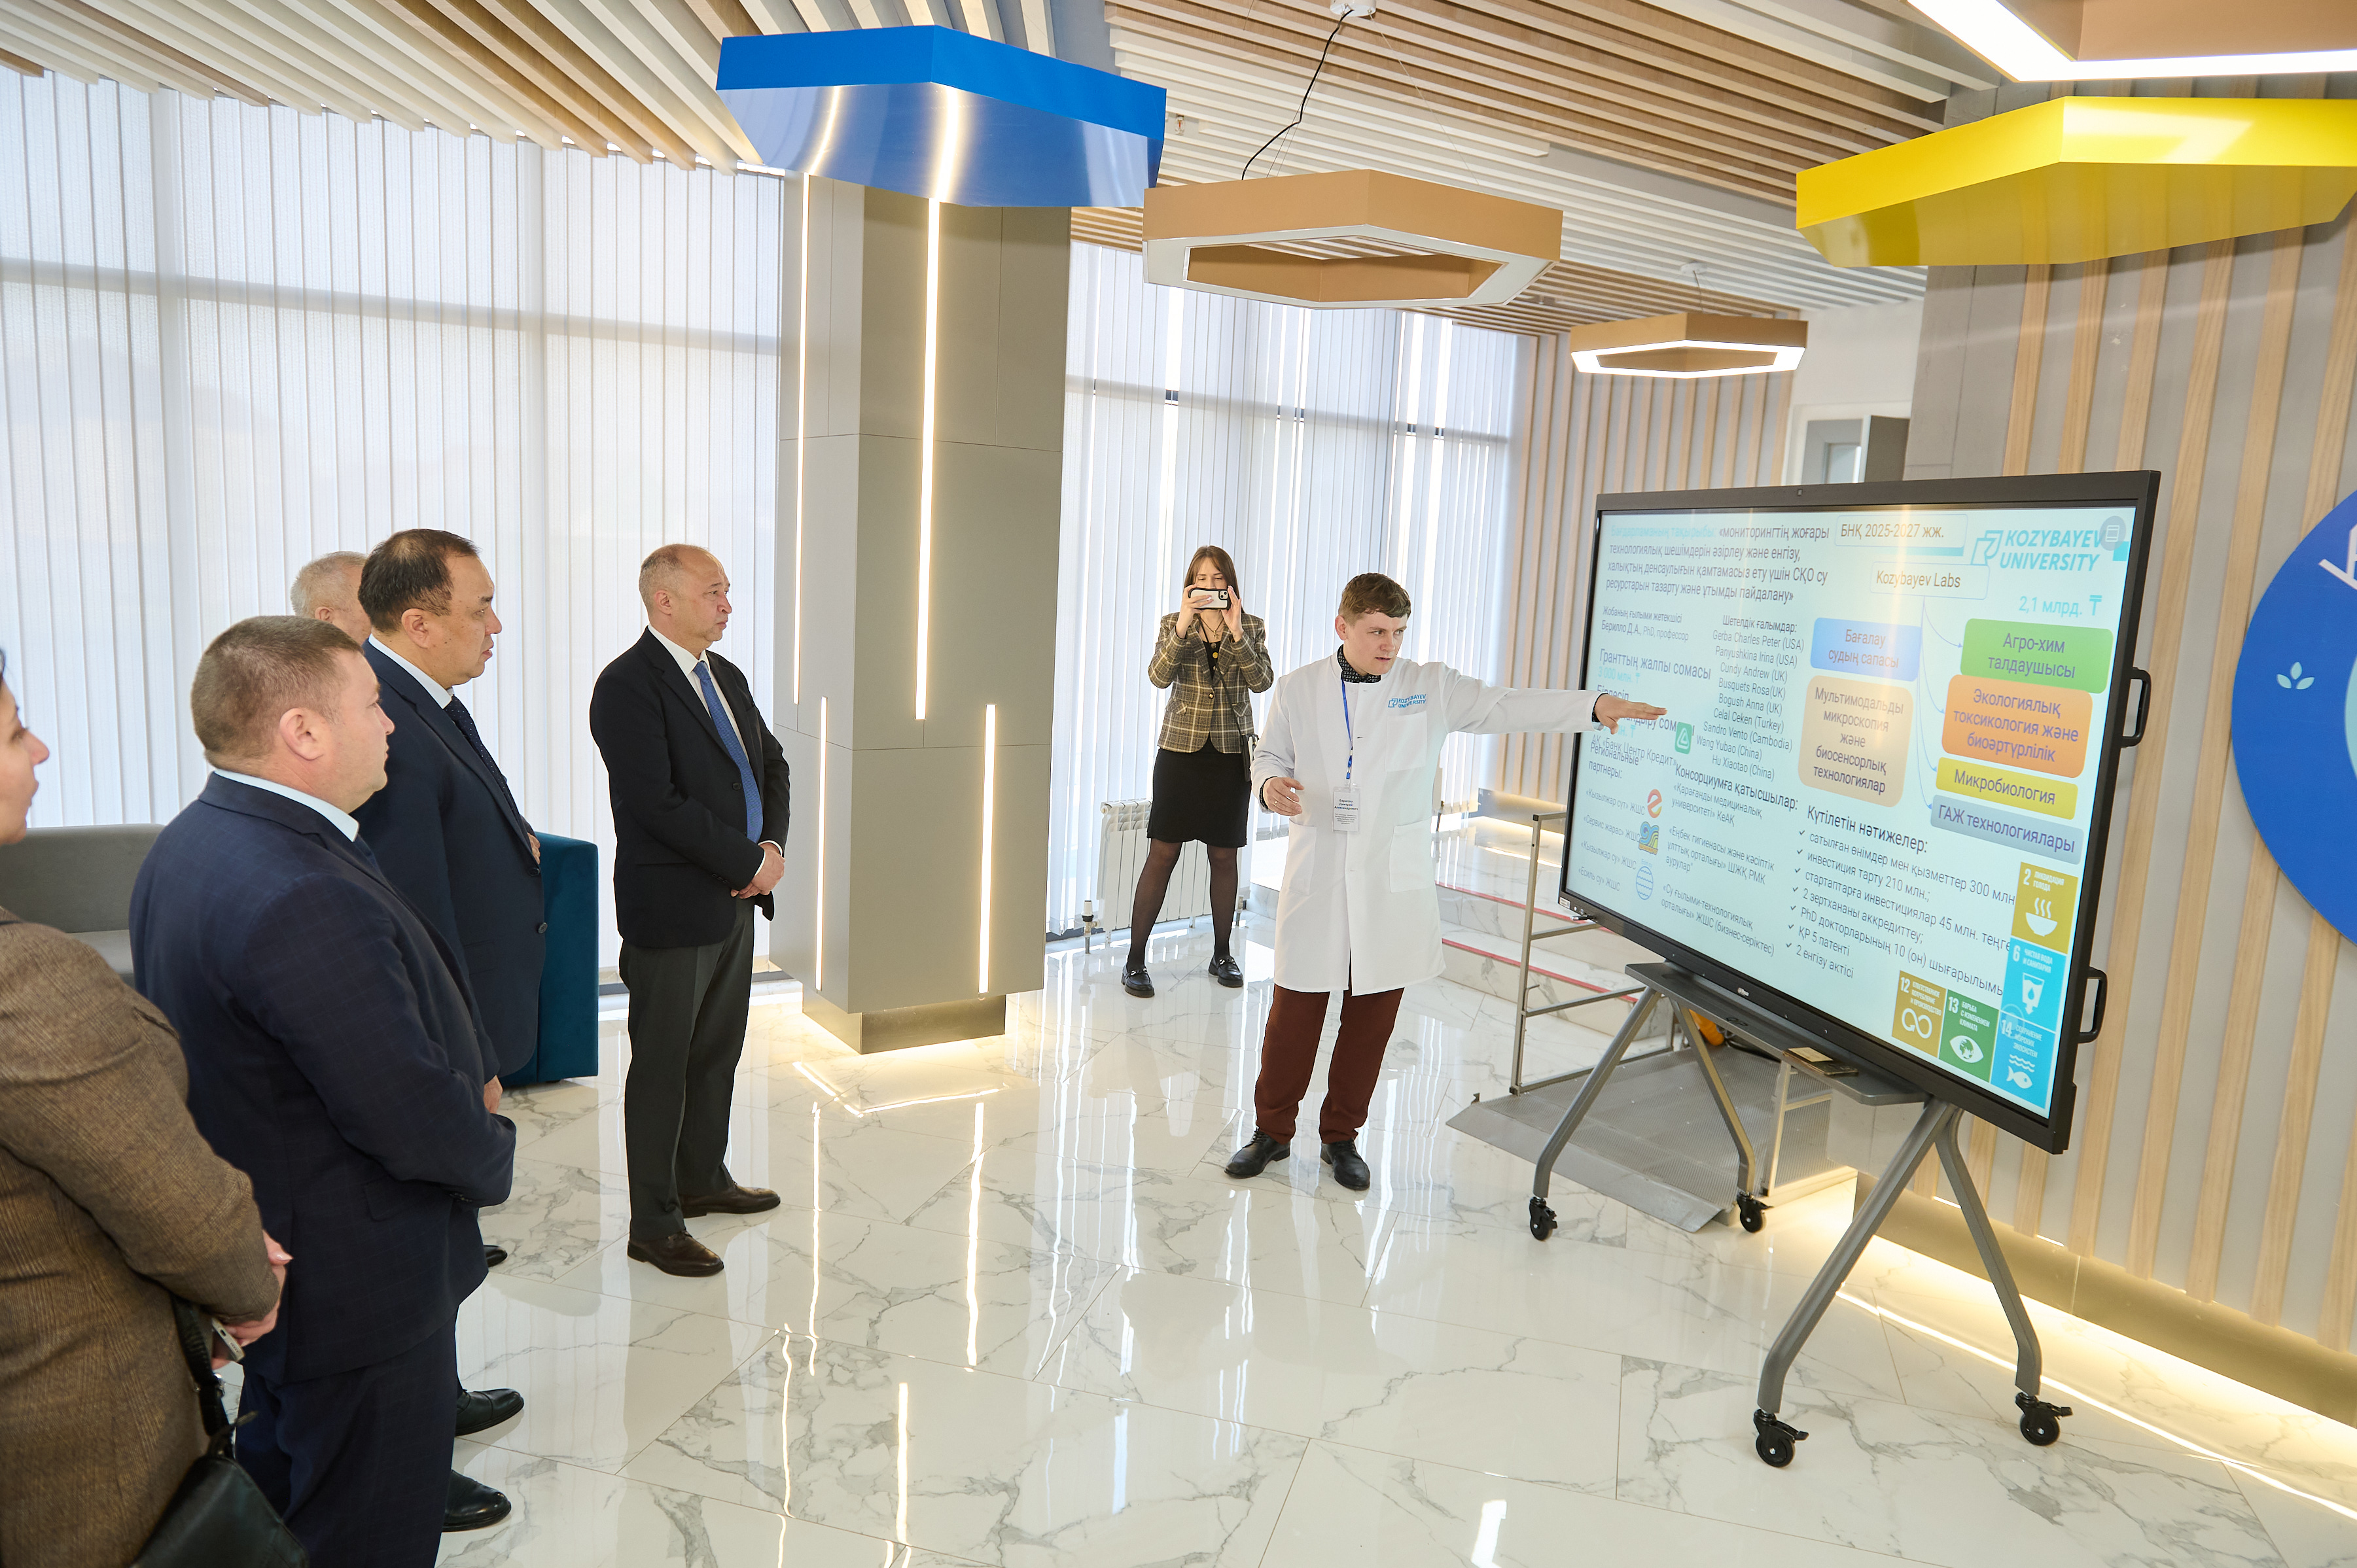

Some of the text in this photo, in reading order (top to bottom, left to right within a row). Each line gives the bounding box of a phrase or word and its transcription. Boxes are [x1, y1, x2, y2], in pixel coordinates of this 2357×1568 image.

[1792, 527, 1830, 542] жоғары
[1841, 523, 1945, 540] БНҚ 2025-2027 жж.
[1610, 544, 1801, 563] технологиялық шешімдерін әзірлеу және енгізу,
[1999, 552, 2100, 572] UNIVERSITY
[1607, 561, 1828, 585] халықтың денсаулығын қамтамасыз ету үшін СҚО су
[1876, 570, 1961, 589] Kozybayev Labs
[1606, 579, 1794, 604] ресурстарын тазарту және ұтымды пайдалану»
[1603, 606, 1682, 623] Жобаның ғылыми жетекшісі
[2019, 596, 2037, 614] 2,1
[2042, 598, 2082, 618] млрд.
[1601, 619, 1627, 634] Берилло
[1656, 629, 1689, 642] профессор
[1722, 615, 1797, 635] Шетелдік ғалымдар:
[1712, 629, 1804, 653] Gerba Charles Peter (USA)
[1845, 629, 1886, 649] Бағалау
[2002, 632, 2065, 653] Агро-хим
[1599, 648, 1711, 680] Гранттың жалпы сомасы
[1715, 646, 1798, 669] Panyushkina Irina (USA)
[1828, 649, 1899, 669] судың сапасы
[1988, 656, 2076, 679] талдаушысы
[1718, 677, 1750, 693] Busquets
[1720, 662, 1788, 684] Cundy Andrew (UK)
[1398, 694, 1427, 704] KOZYBAYEV
[1398, 699, 1427, 708] UNIVERSITY
[1718, 693, 1782, 717] Bogush Anna (UK)
[1815, 686, 1904, 715] Мультимодальды
[1973, 688, 2061, 719] Экологиялық
[1714, 708, 1784, 734] Celal Ceken (Turkey)
[1823, 710, 1890, 733] микроскопия
[1953, 709, 2079, 740] токсикология және
[1696, 735, 1762, 762] Wang Yubao (China)
[1703, 722, 1793, 752] Sandro Vento (Cambodia)
[1839, 733, 1866, 748] және
[1966, 732, 2056, 763] биоәртүрлілік
[1591, 741, 1639, 765] Региональные
[1815, 744, 1887, 776] биосенсорлық
[1589, 761, 1622, 778] партнеры:
[1712, 754, 1775, 781] Hu Xiaotao (China)
[1675, 763, 1798, 812] Консорциумға қатысшылар:
[1813, 765, 1886, 795] технологиялар
[1954, 768, 2056, 805] Микробиология
[1671, 798, 1735, 827] университеті» КеАҚ
[1673, 782, 1762, 820] «Қарағанды медициналық
[1807, 805, 1928, 855] Күтілетін нәтижелер:
[1938, 805, 2075, 853] ГАЖ технологиялары
[1669, 826, 1775, 871] «Еңбек гигиенасы және кәсіптік
[1668, 841, 1690, 856] ұлттық
[1691, 850, 1726, 869] орталығы»
[1728, 862, 1747, 880] ШЖҚ
[1748, 869, 1766, 885] РМК
[1807, 852, 1856, 877] инвестиция
[1859, 867, 1884, 887] тарту
[1885, 875, 1903, 892] 210
[1809, 831, 1849, 853] сатылған
[1851, 843, 1888, 867] өнімдер
[1890, 857, 1909, 872] мен
[1911, 863, 1967, 892] қызметтер
[1969, 879, 1990, 897] 300
[2023, 868, 2032, 886] 2
[1803, 888, 1924, 945] 2 зертхананы аккредиттеу;
[1805, 869, 1862, 900] стартаптарға
[1864, 890, 1937, 926] инвестициялар
[1939, 915, 1953, 931] 45
[1955, 924, 1978, 941] млн.
[1661, 898, 1775, 957] орталығы» ЖШС (бизнес-серіктес)
[1801, 906, 1817, 922] PhD
[1818, 915, 1891, 955] докторларының
[1895, 943, 1905, 958] 10
[1907, 947, 1926, 969] (он)
[1799, 926, 1851, 956] ҚР 5 патенті
[1796, 945, 1854, 979] 2 енгізу актісі
[2012, 945, 2021, 962] 6
[1900, 977, 1910, 994] 12
[1948, 996, 1959, 1014] 13
[2002, 1019, 2012, 1037] 14
